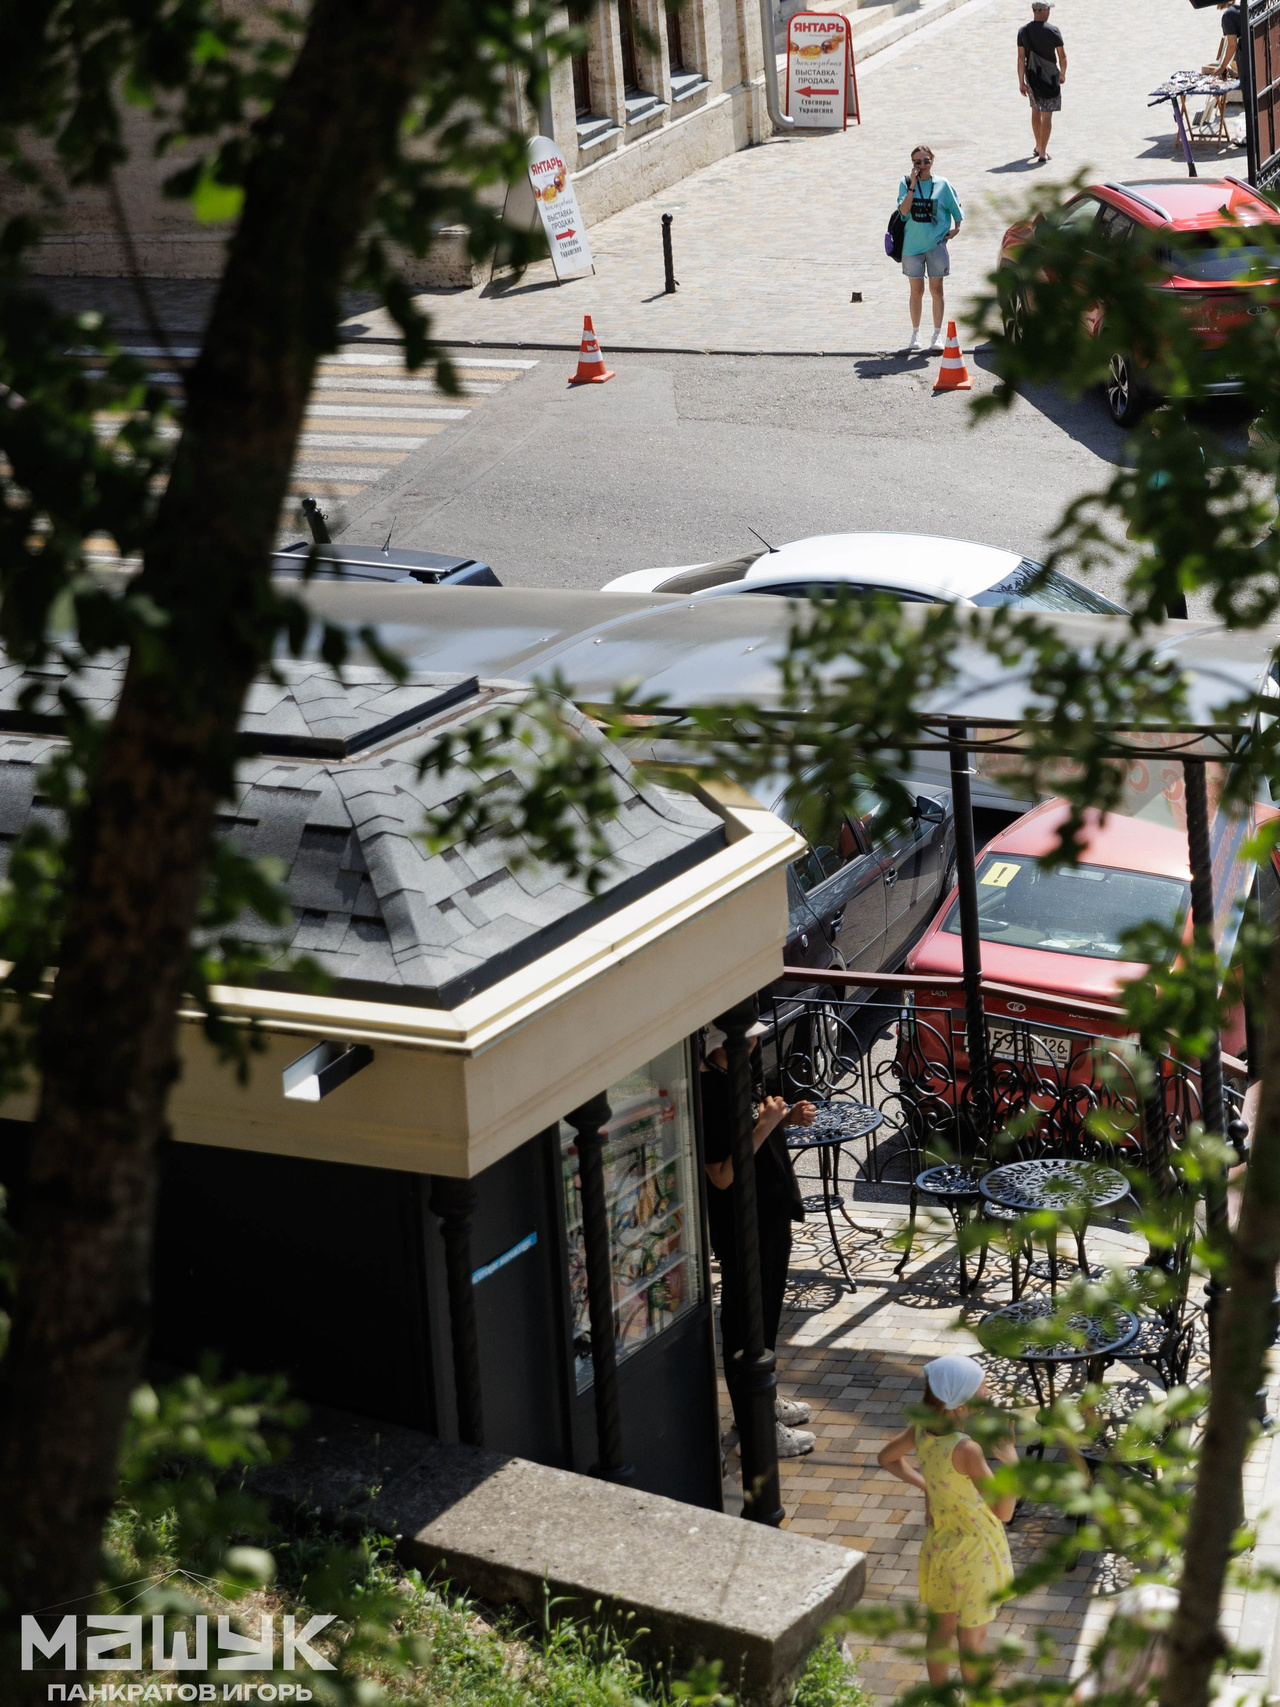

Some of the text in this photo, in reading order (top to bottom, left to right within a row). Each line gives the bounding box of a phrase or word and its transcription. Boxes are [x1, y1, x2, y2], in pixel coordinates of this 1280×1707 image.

[793, 22, 845, 33] ЯНТАРЬ
[795, 69, 839, 77] ВЫСТАВКА-
[798, 77, 835, 85] ПРОДАЖА
[531, 157, 563, 176] ЯНТАРЬ
[546, 208, 575, 223] ВЫСТАВКА-
[551, 217, 576, 231] ПРОДАЖА
